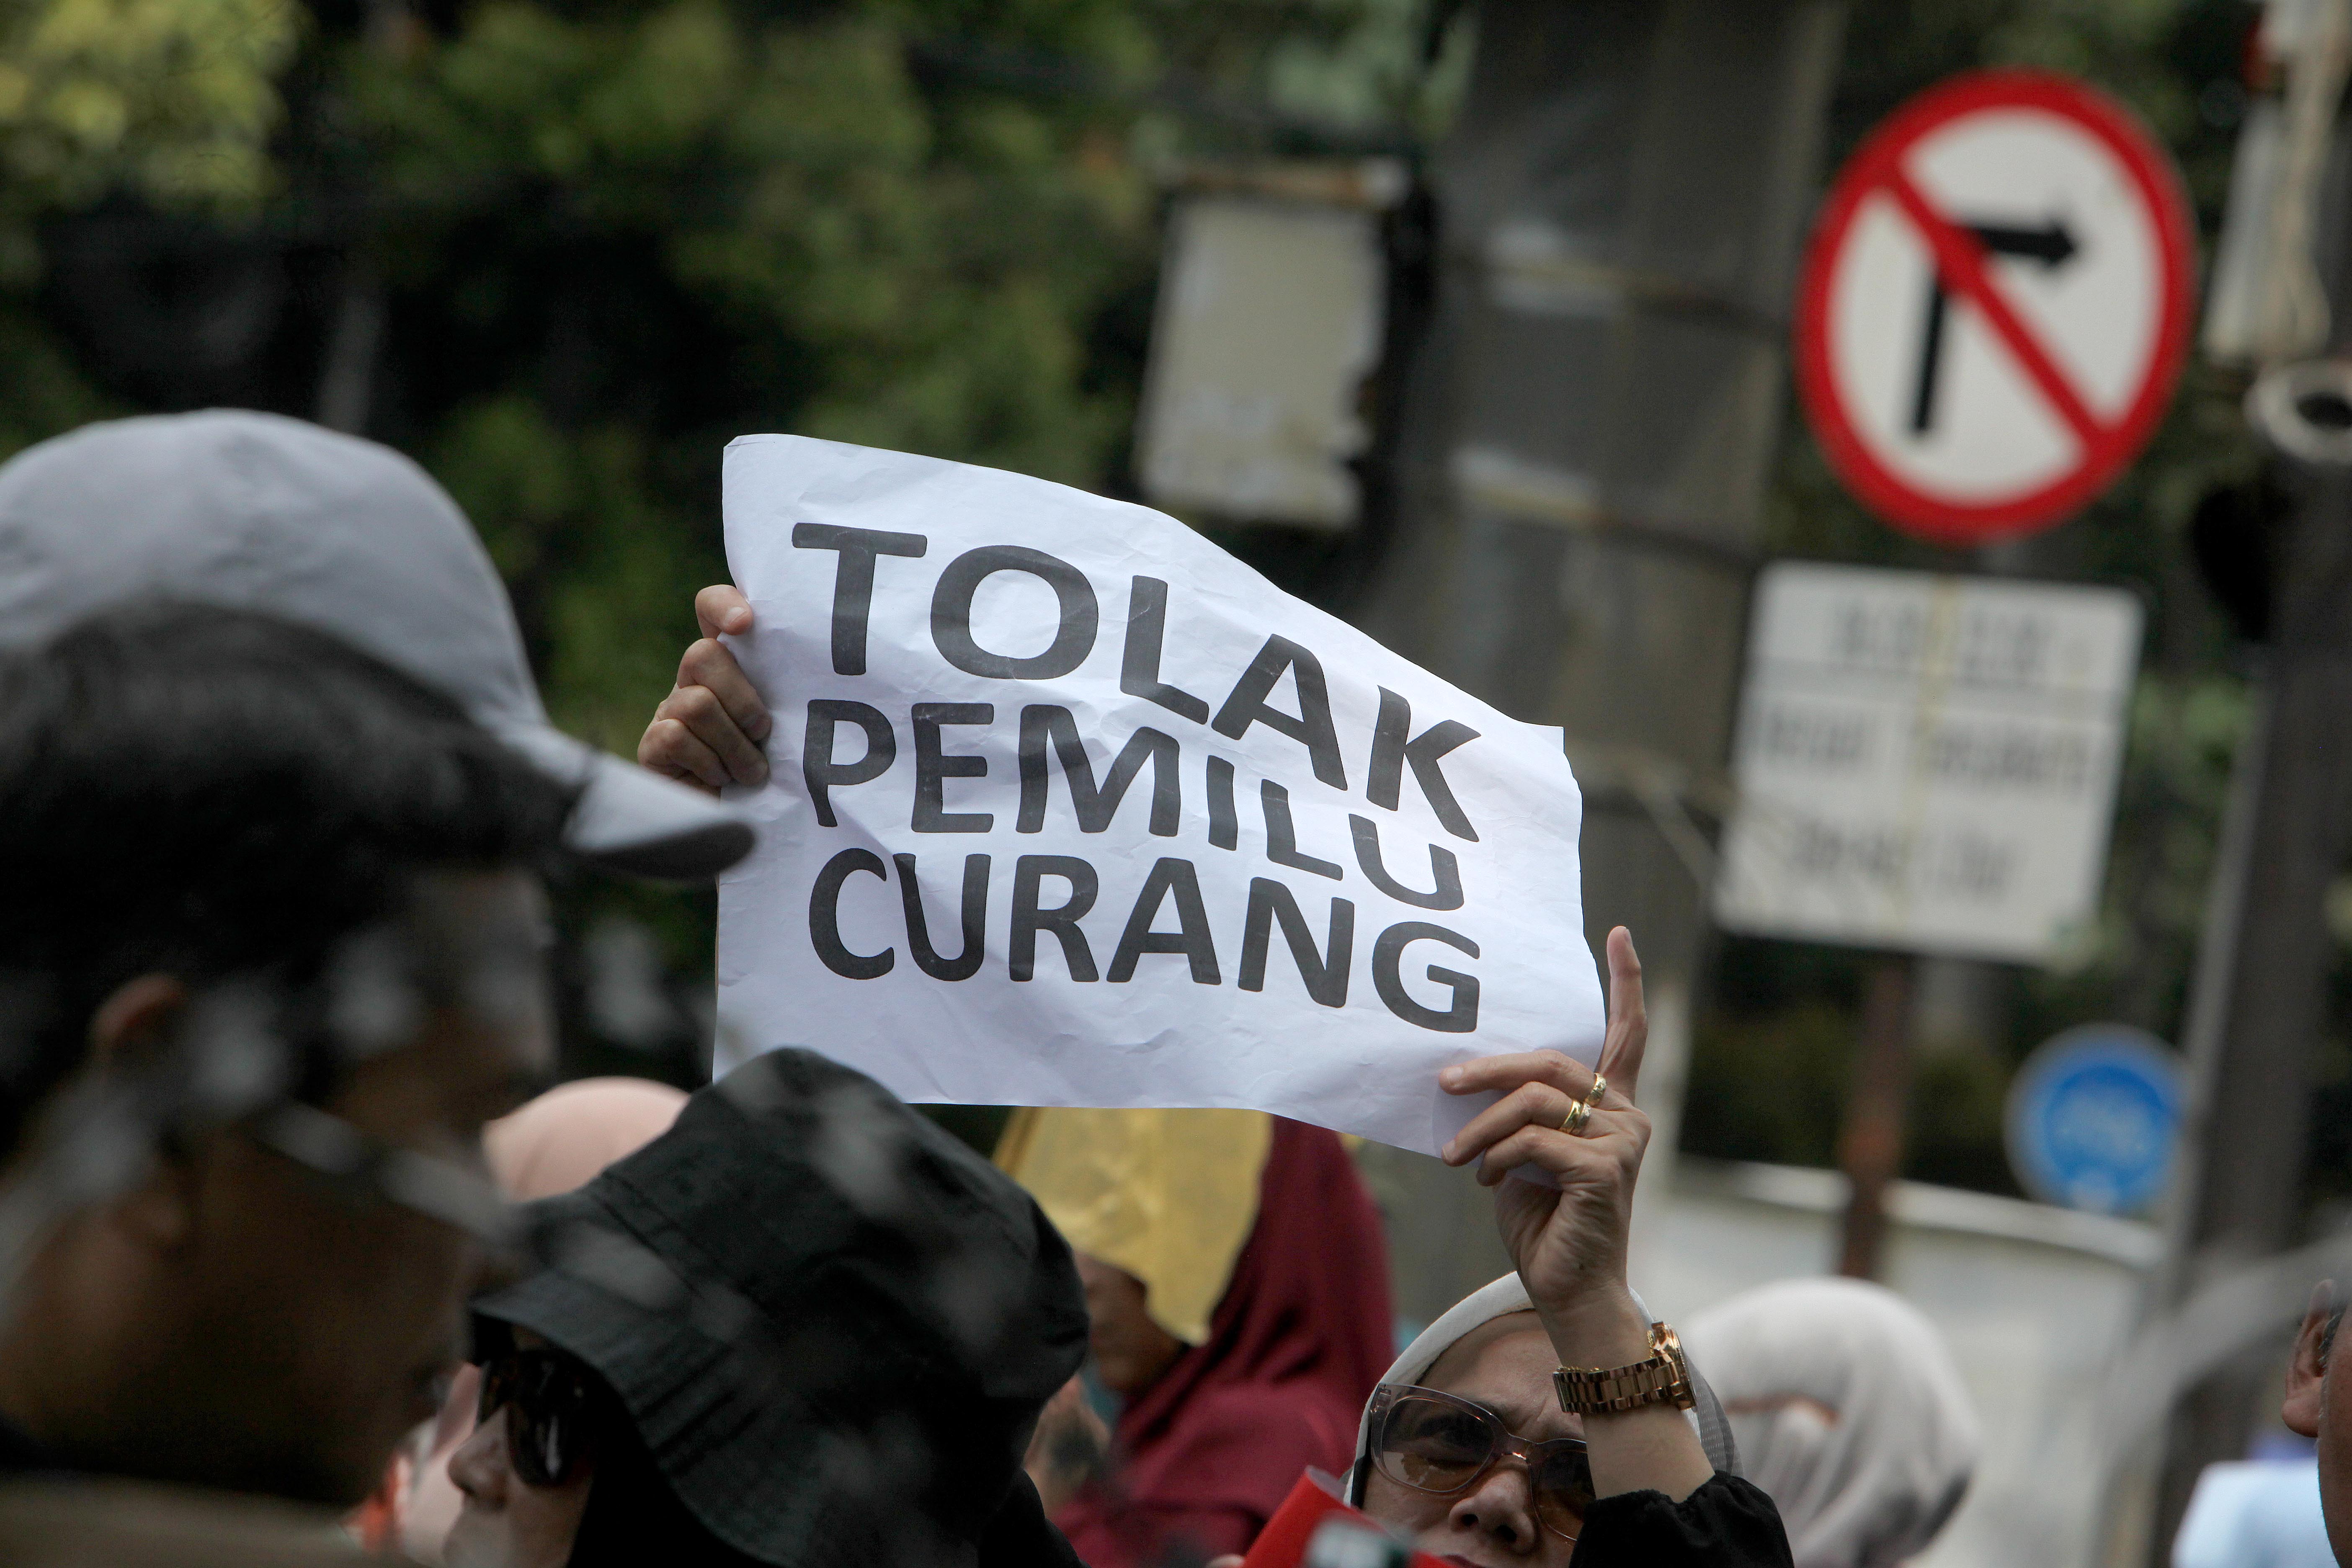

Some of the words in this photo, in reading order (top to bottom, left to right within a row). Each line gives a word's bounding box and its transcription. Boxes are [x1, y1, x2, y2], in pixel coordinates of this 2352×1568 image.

[792, 522, 1481, 842] TOLAK
[802, 698, 1464, 911] PEMILU
[808, 847, 1480, 1033] CURANG
